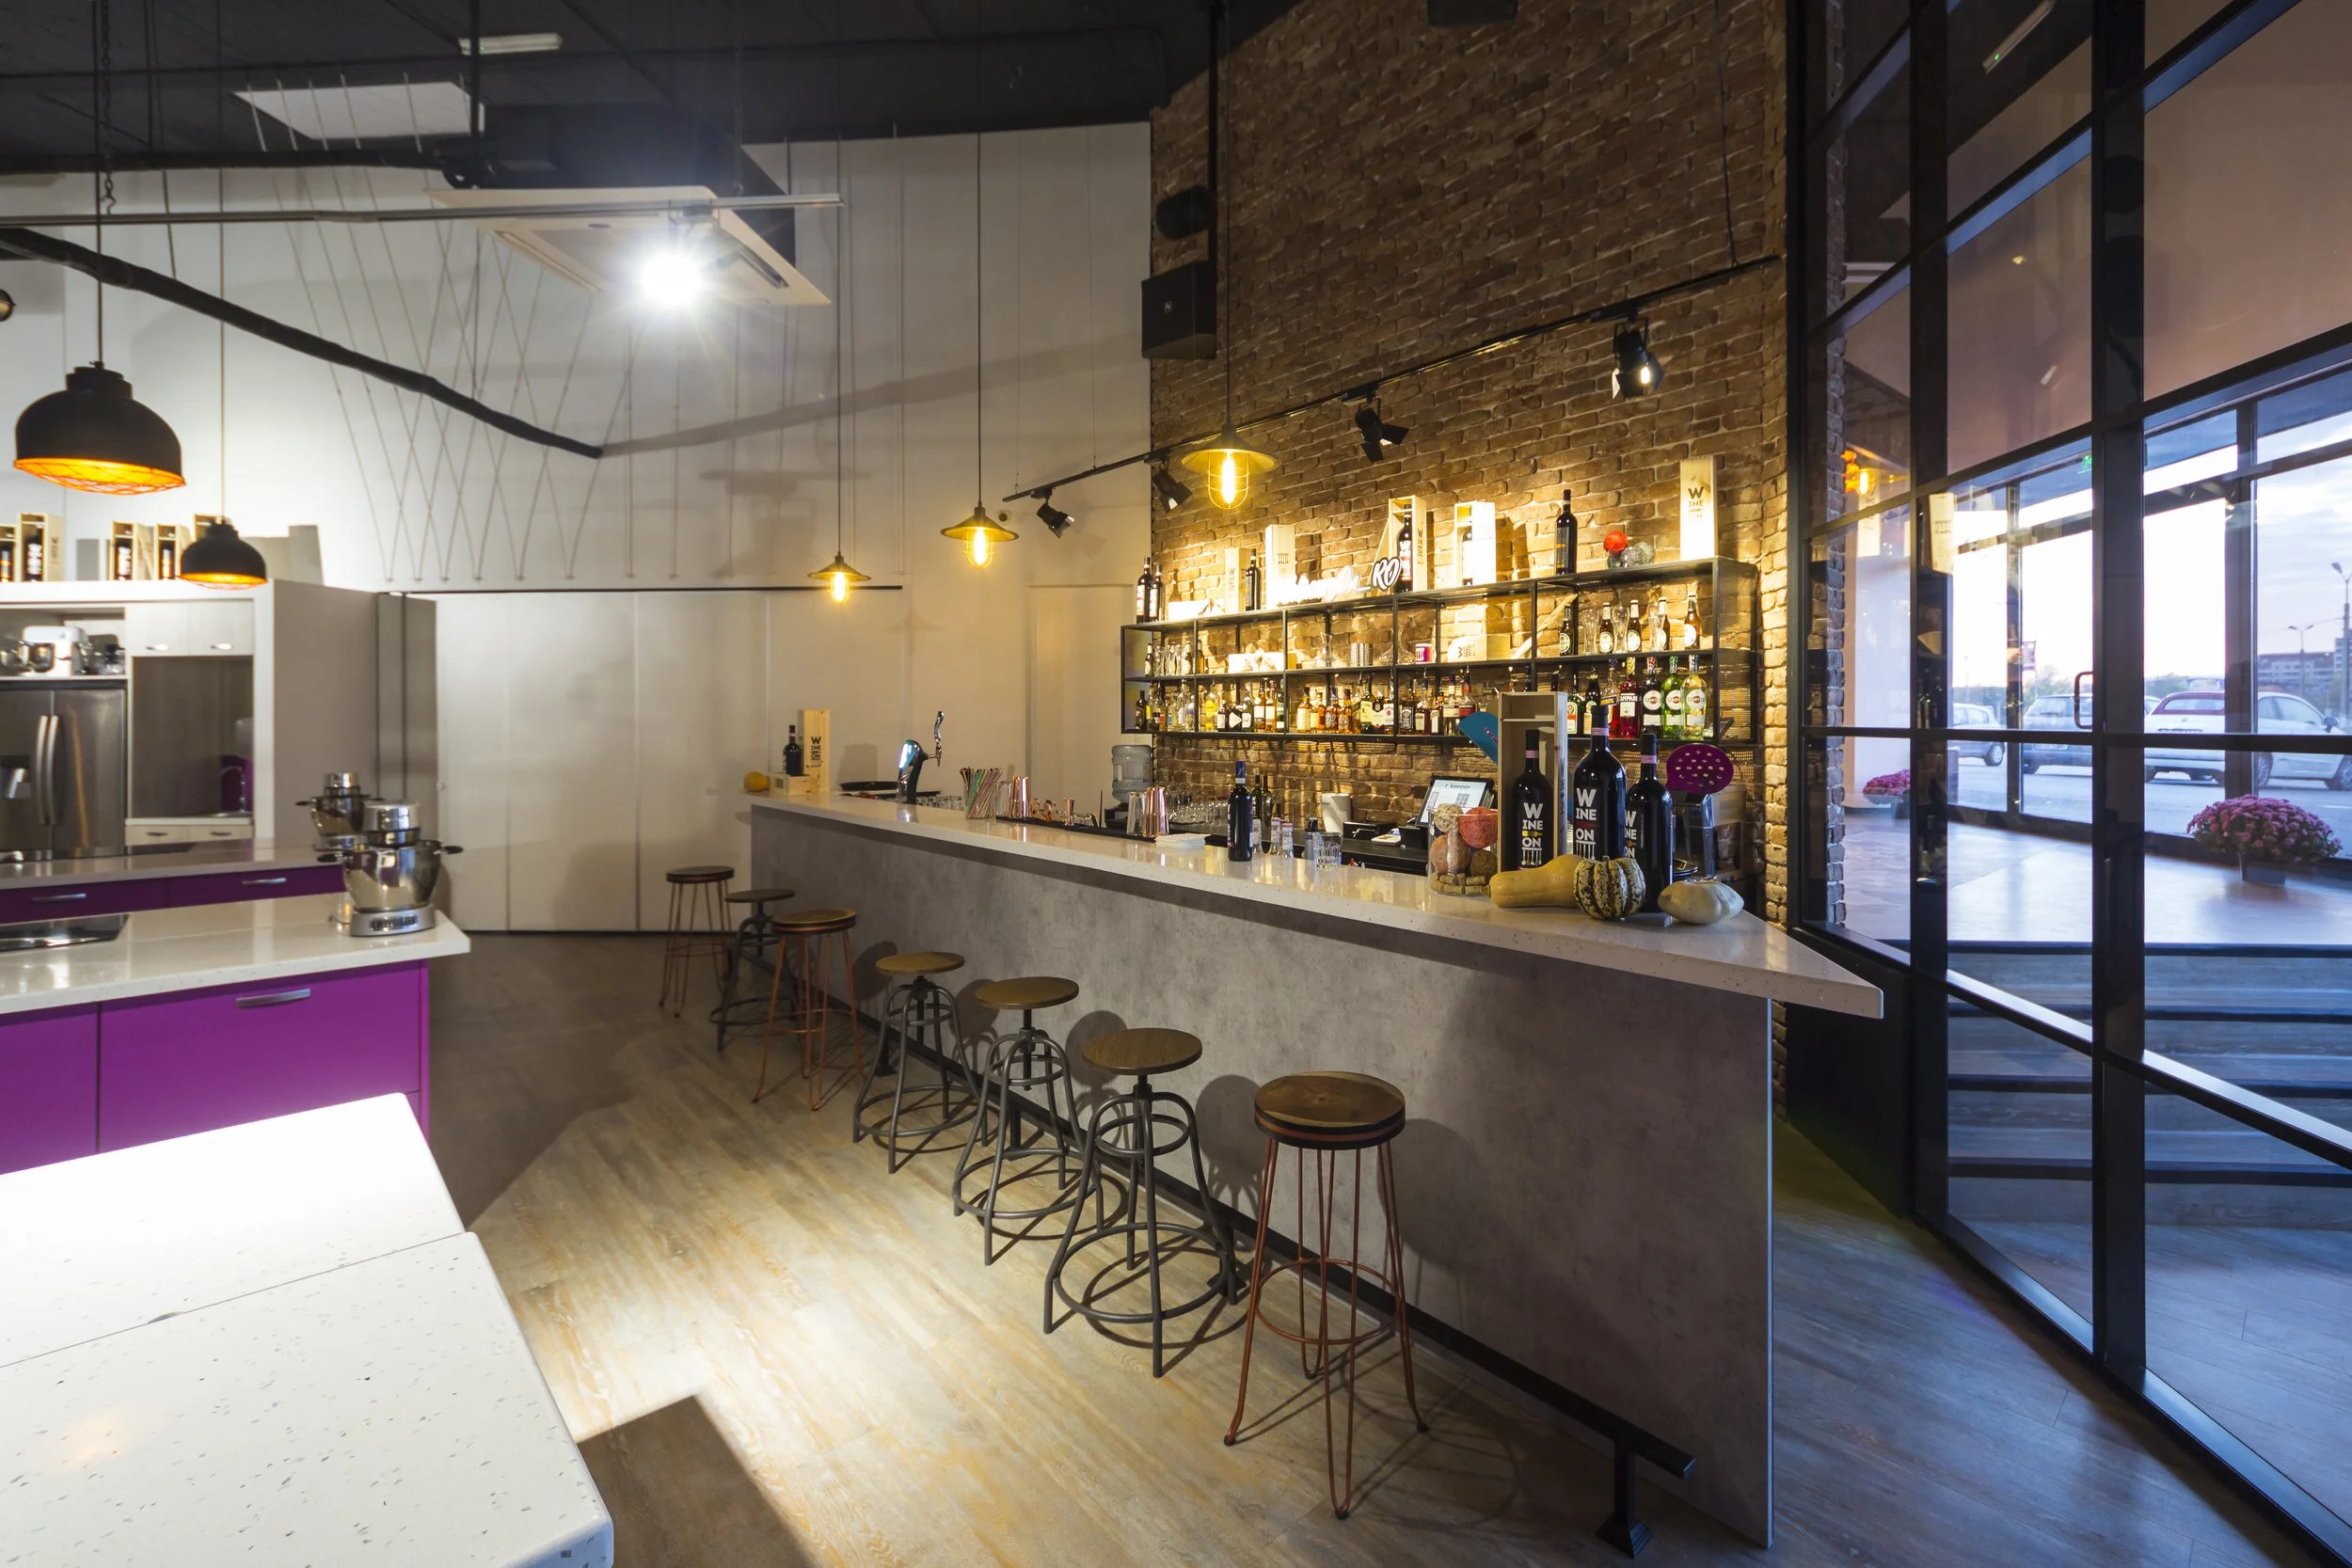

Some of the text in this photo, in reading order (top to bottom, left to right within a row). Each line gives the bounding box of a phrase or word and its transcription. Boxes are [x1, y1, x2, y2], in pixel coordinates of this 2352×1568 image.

[1688, 486, 1705, 499] W
[811, 736, 821, 745] W
[1576, 787, 1597, 807] W
[1523, 802, 1544, 819] W
[1576, 807, 1597, 820] INE
[1522, 819, 1544, 831] INE
[1625, 811, 1637, 828] W
[1575, 829, 1595, 841] ON
[1625, 829, 1637, 840] NE
[1521, 837, 1542, 847] ON
